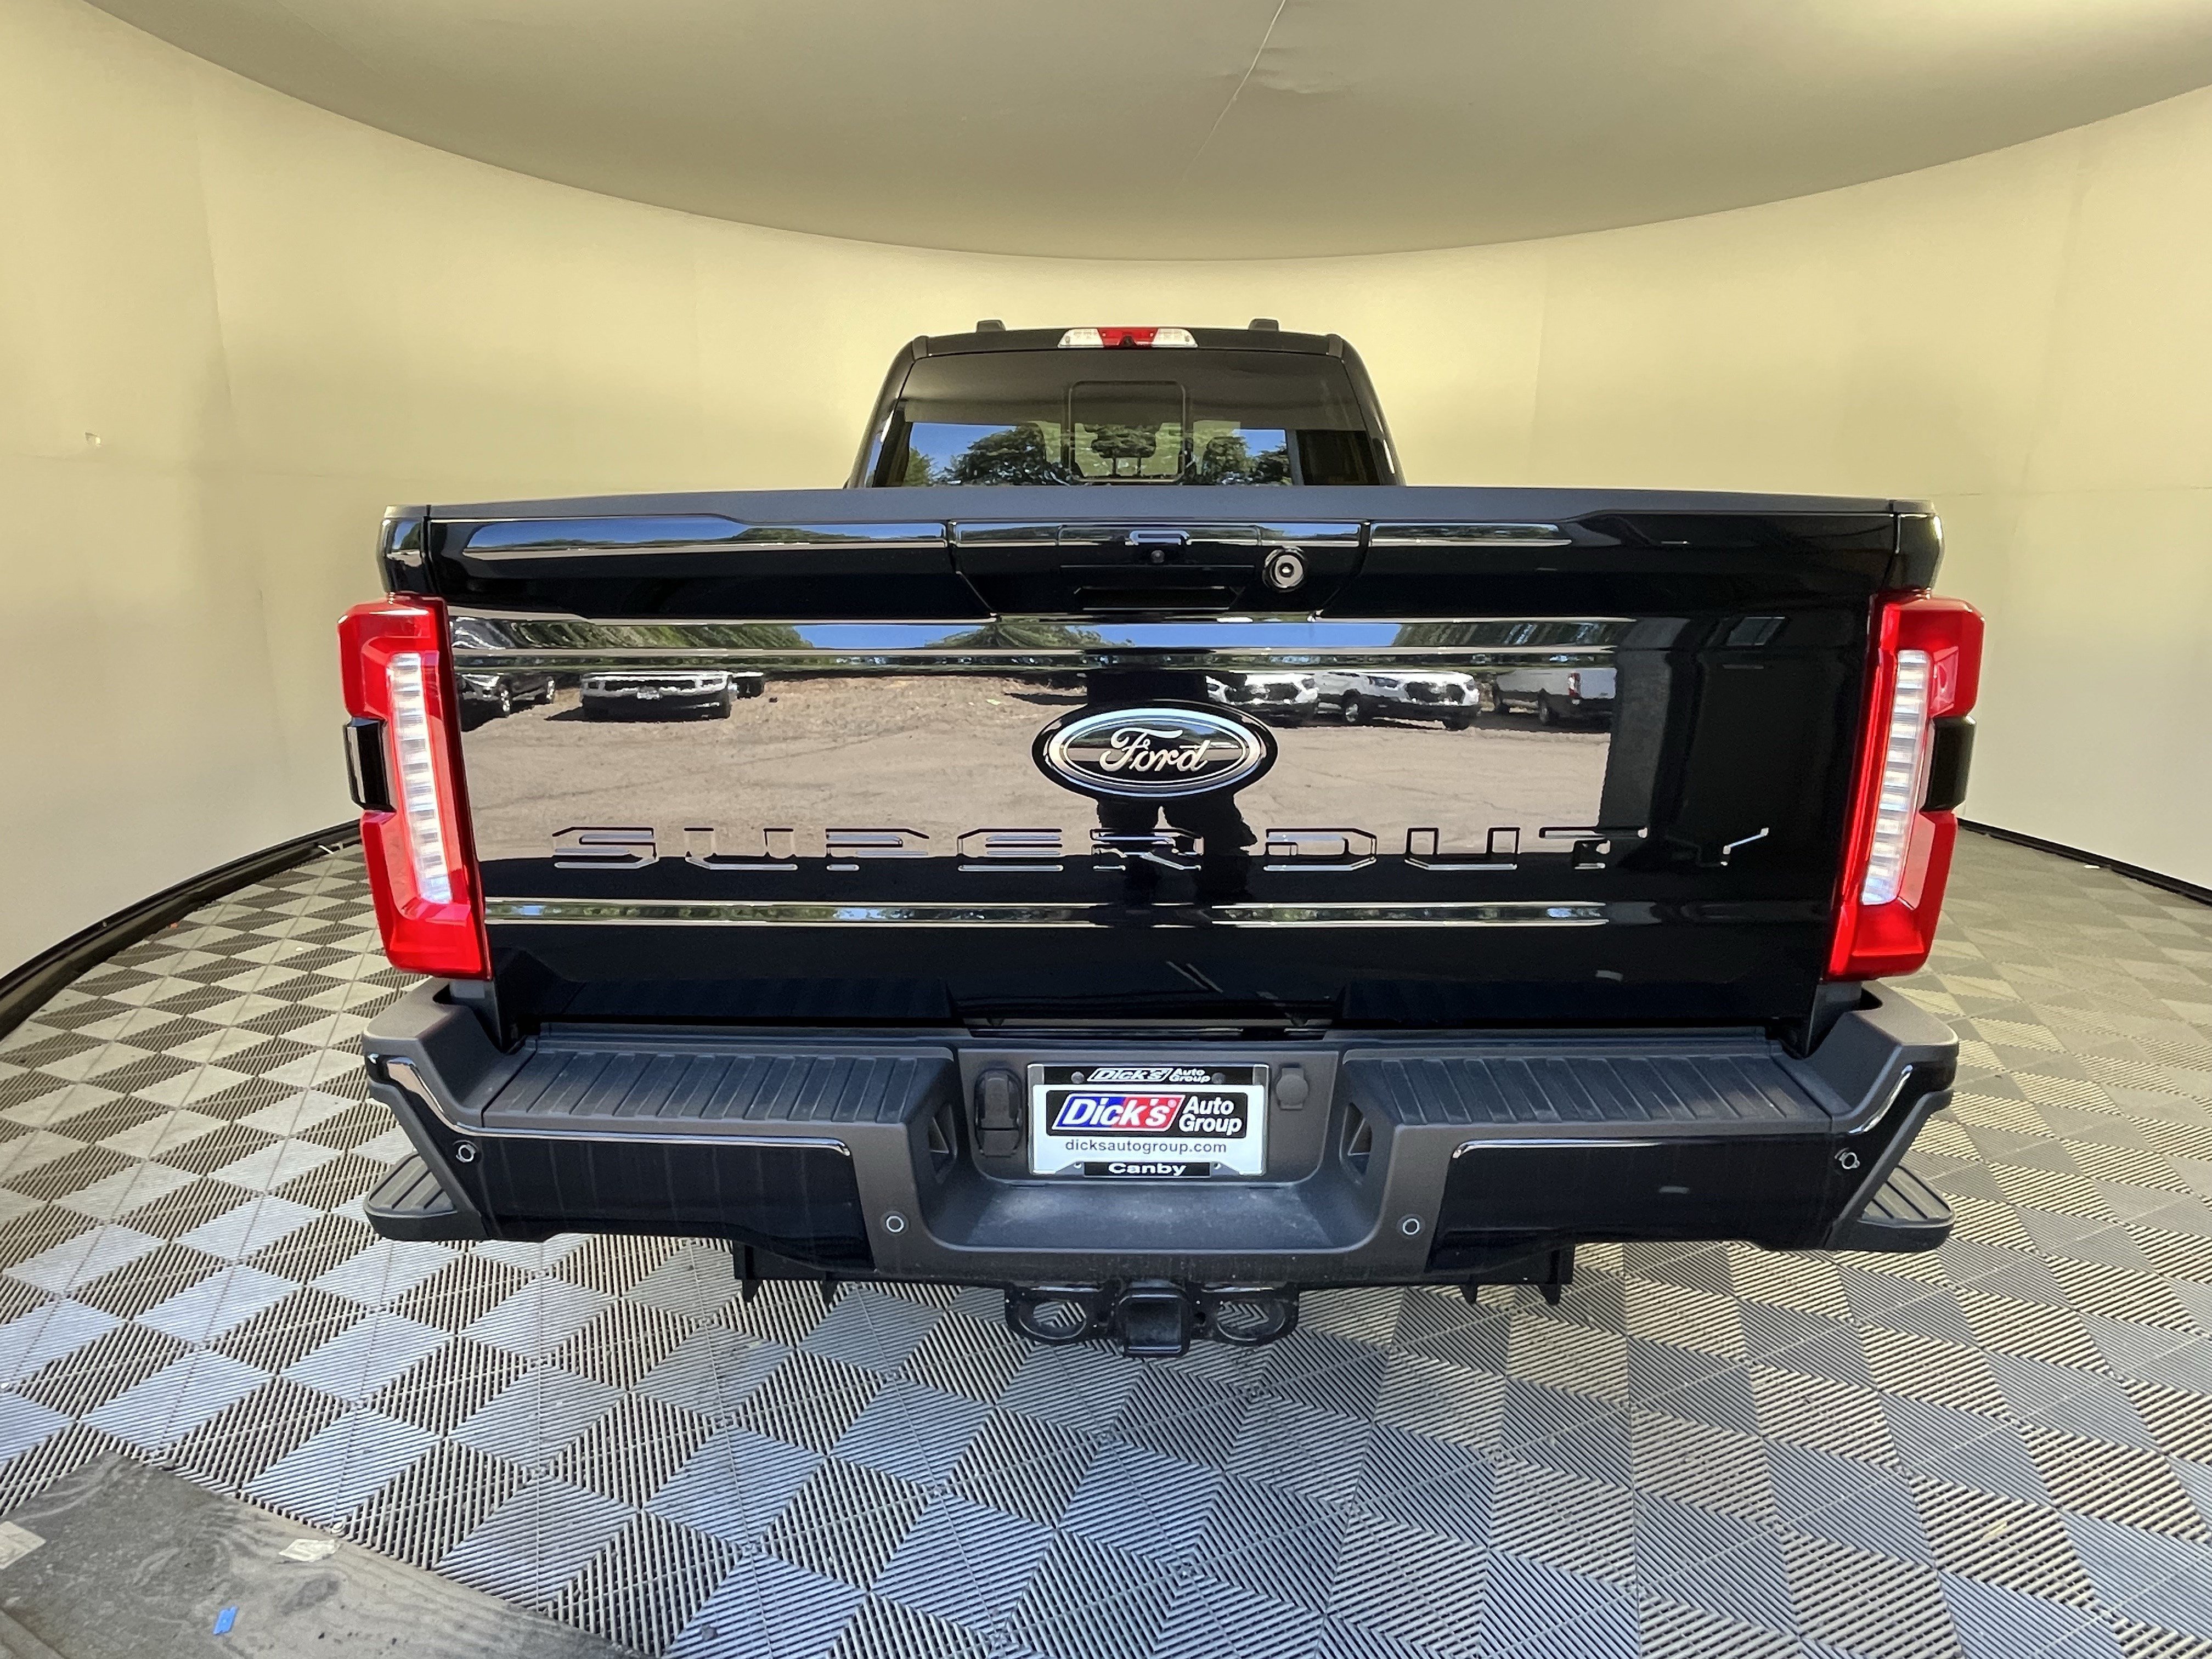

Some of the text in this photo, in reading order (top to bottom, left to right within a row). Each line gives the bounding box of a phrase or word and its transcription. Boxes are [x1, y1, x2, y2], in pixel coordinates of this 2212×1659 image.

[1099, 727, 1211, 771] Ford
[552, 827, 1204, 872] SUPER
[1093, 1068, 1167, 1082] Dick's
[1169, 1074, 1210, 1083] Group
[1175, 1068, 1205, 1076] Auto
[1062, 1097, 1170, 1127] Dick's
[1182, 1096, 1234, 1115] Auto
[1178, 1113, 1243, 1136] Group
[1065, 1139, 1227, 1154] dicksautogroup.com
[1108, 1163, 1187, 1176] Canby
